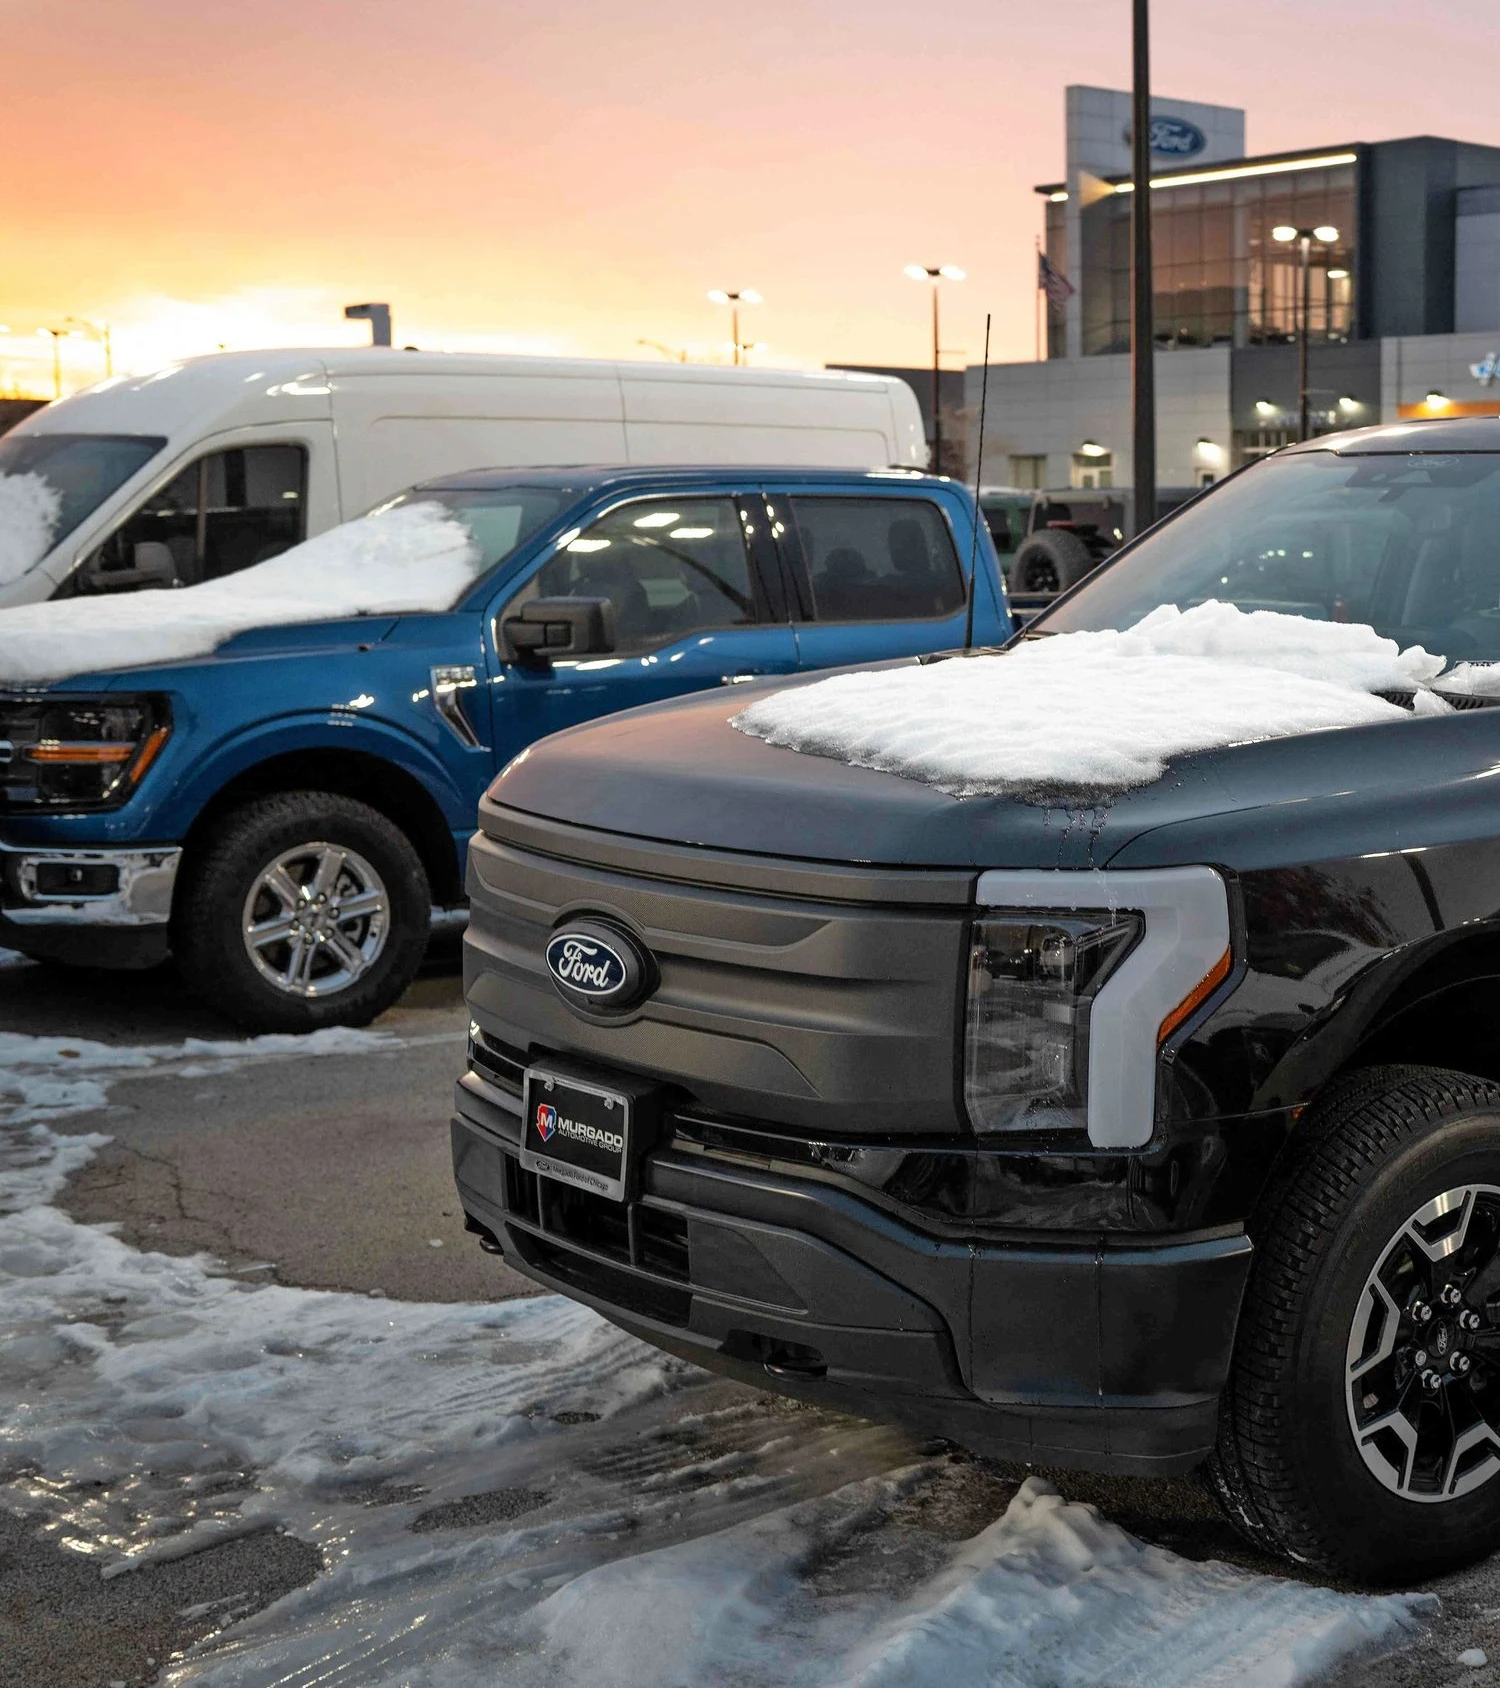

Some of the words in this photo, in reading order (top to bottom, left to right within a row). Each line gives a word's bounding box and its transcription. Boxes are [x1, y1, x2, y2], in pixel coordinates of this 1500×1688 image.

[558, 940, 611, 988] Ford
[540, 1112, 553, 1129] M
[558, 1117, 623, 1148] MURGADO
[558, 1129, 598, 1146] AUTOMOTIVE
[598, 1141, 622, 1153] GROUP
